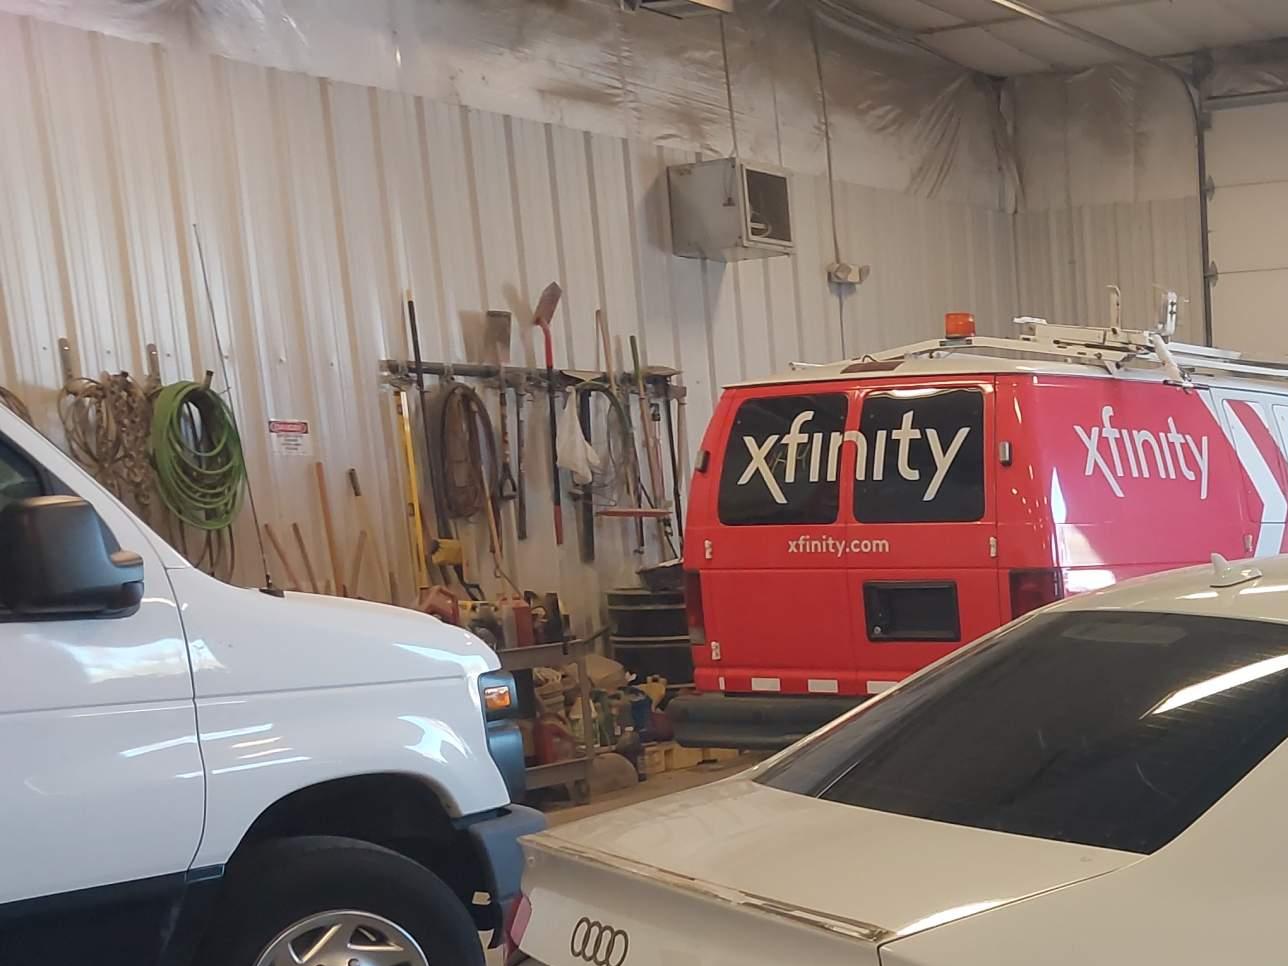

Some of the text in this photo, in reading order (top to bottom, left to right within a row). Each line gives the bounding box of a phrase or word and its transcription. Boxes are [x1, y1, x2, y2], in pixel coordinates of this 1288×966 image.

[737, 410, 971, 504] xfinity
[1073, 405, 1208, 500] xfinity
[788, 535, 889, 558] xfinity.com
